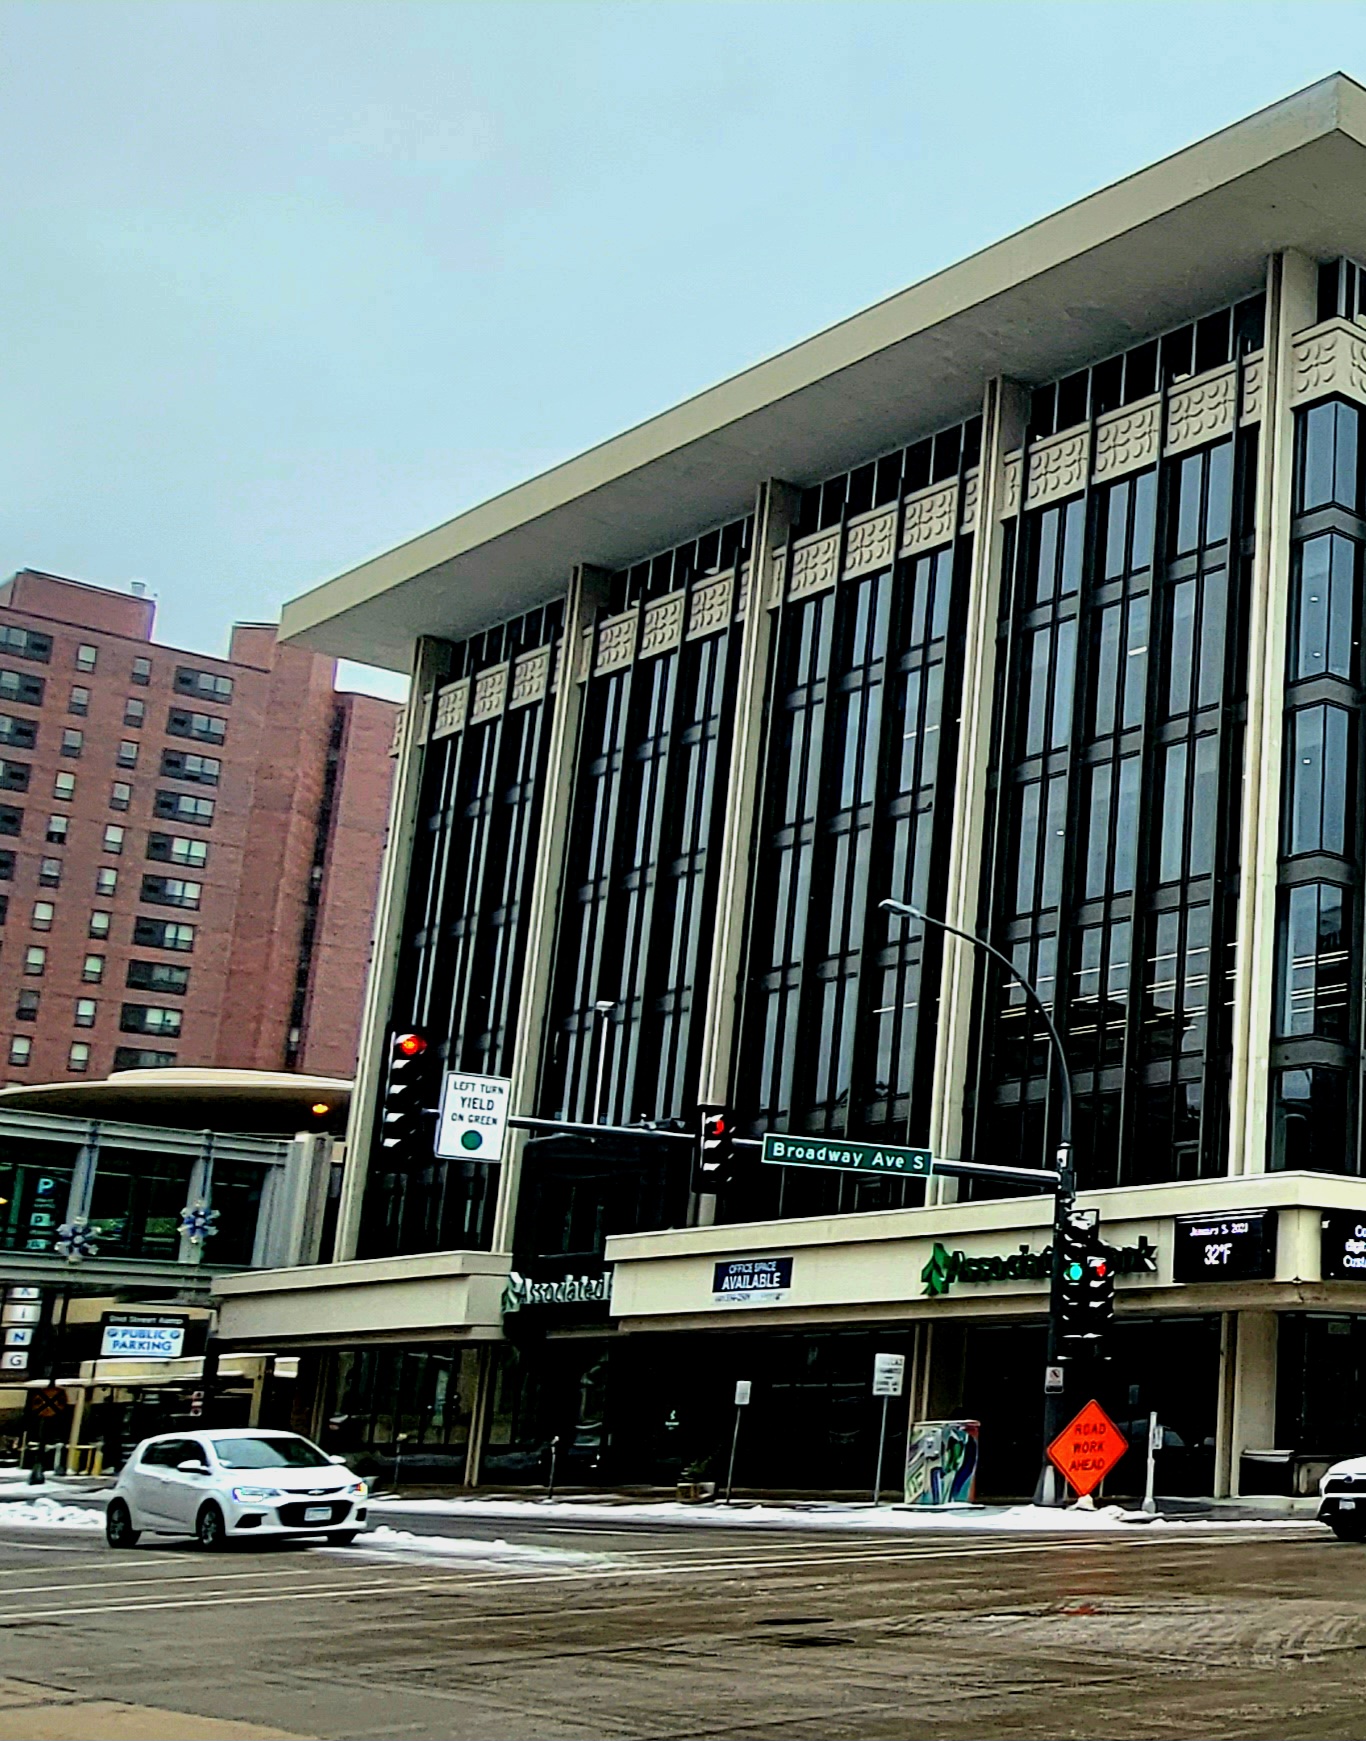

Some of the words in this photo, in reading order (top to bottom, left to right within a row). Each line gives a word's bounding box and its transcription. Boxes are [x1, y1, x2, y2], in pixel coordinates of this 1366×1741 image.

[453, 1081, 476, 1092] LEFT
[480, 1083, 504, 1094] TURN
[461, 1096, 495, 1110] YIELD
[451, 1112, 464, 1122] ON
[468, 1114, 498, 1125] GREEN
[773, 1142, 863, 1167] Broadway
[872, 1151, 905, 1168] Ave
[912, 1155, 924, 1170] S
[728, 1263, 753, 1274] OFFICE
[754, 1261, 777, 1272] SPACE
[721, 1272, 781, 1290] AVAILABLE
[121, 1329, 166, 1339] PUBLIC
[112, 1340, 172, 1351] PARKING
[1075, 1423, 1106, 1436] ROAD
[1073, 1441, 1105, 1454] WORK
[1069, 1457, 1105, 1472] AHEAD
